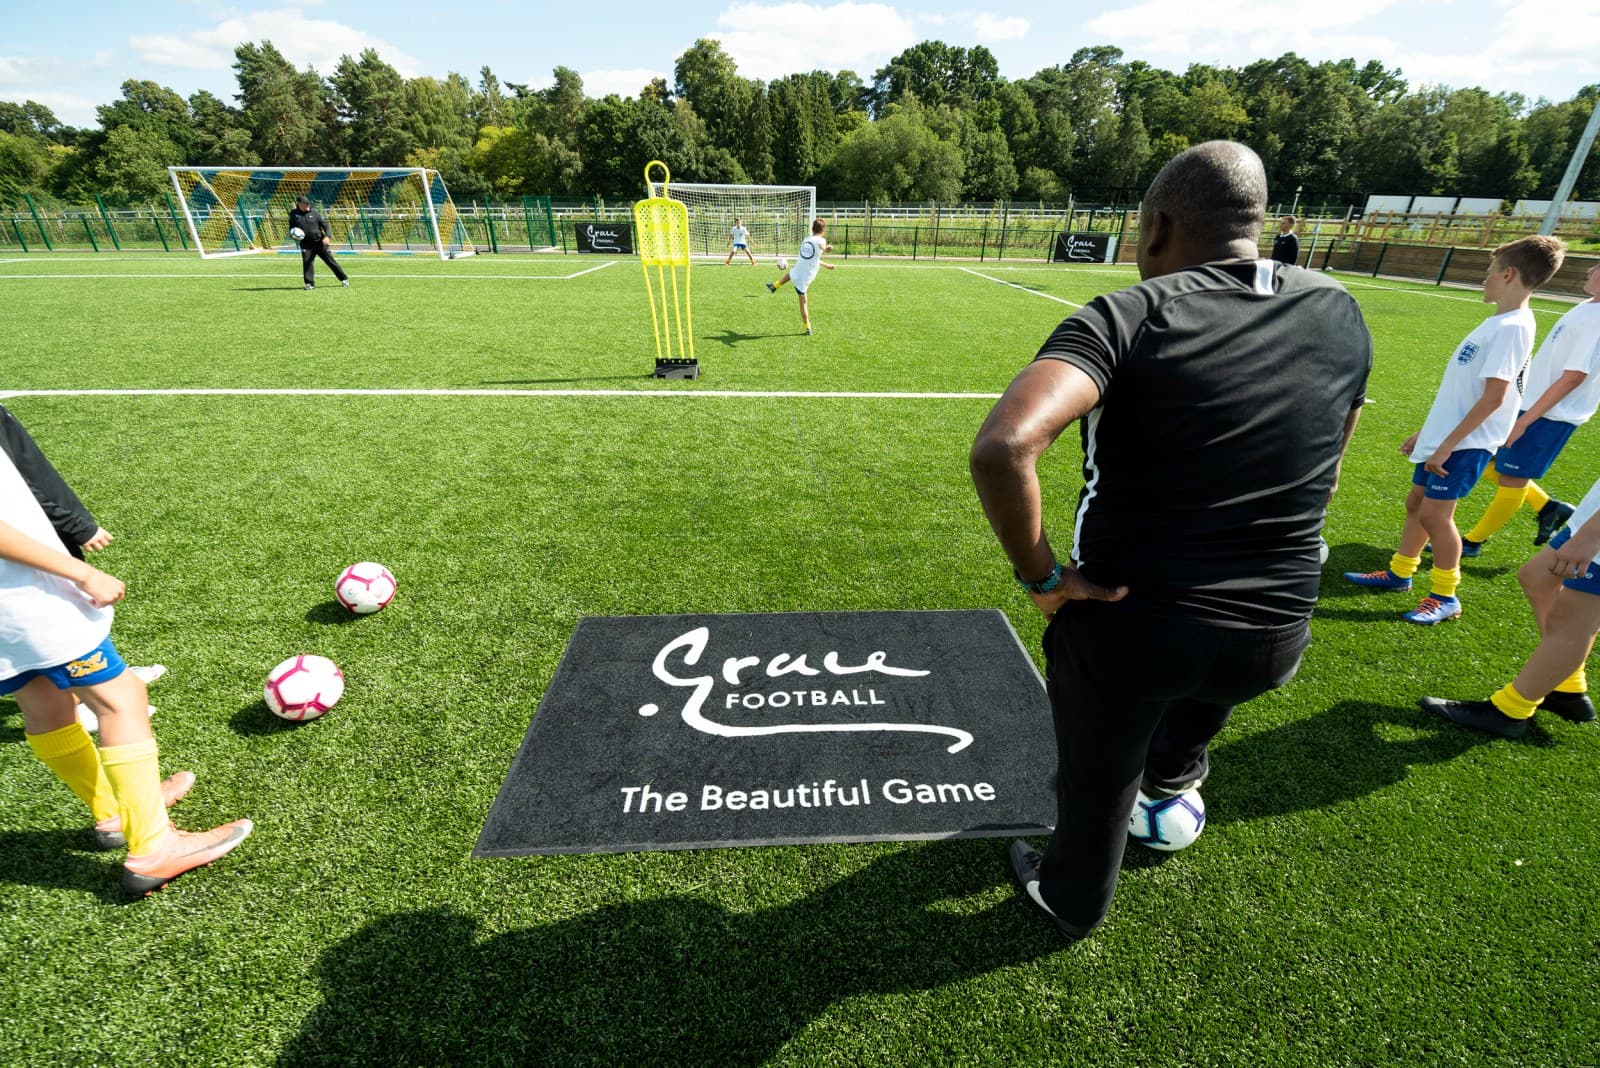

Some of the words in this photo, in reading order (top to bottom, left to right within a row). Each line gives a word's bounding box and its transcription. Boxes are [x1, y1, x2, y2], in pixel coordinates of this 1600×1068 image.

[725, 688, 886, 710] FOOTBALL
[620, 784, 689, 813] The
[700, 778, 871, 811] Beautiful
[882, 778, 996, 804] Game
